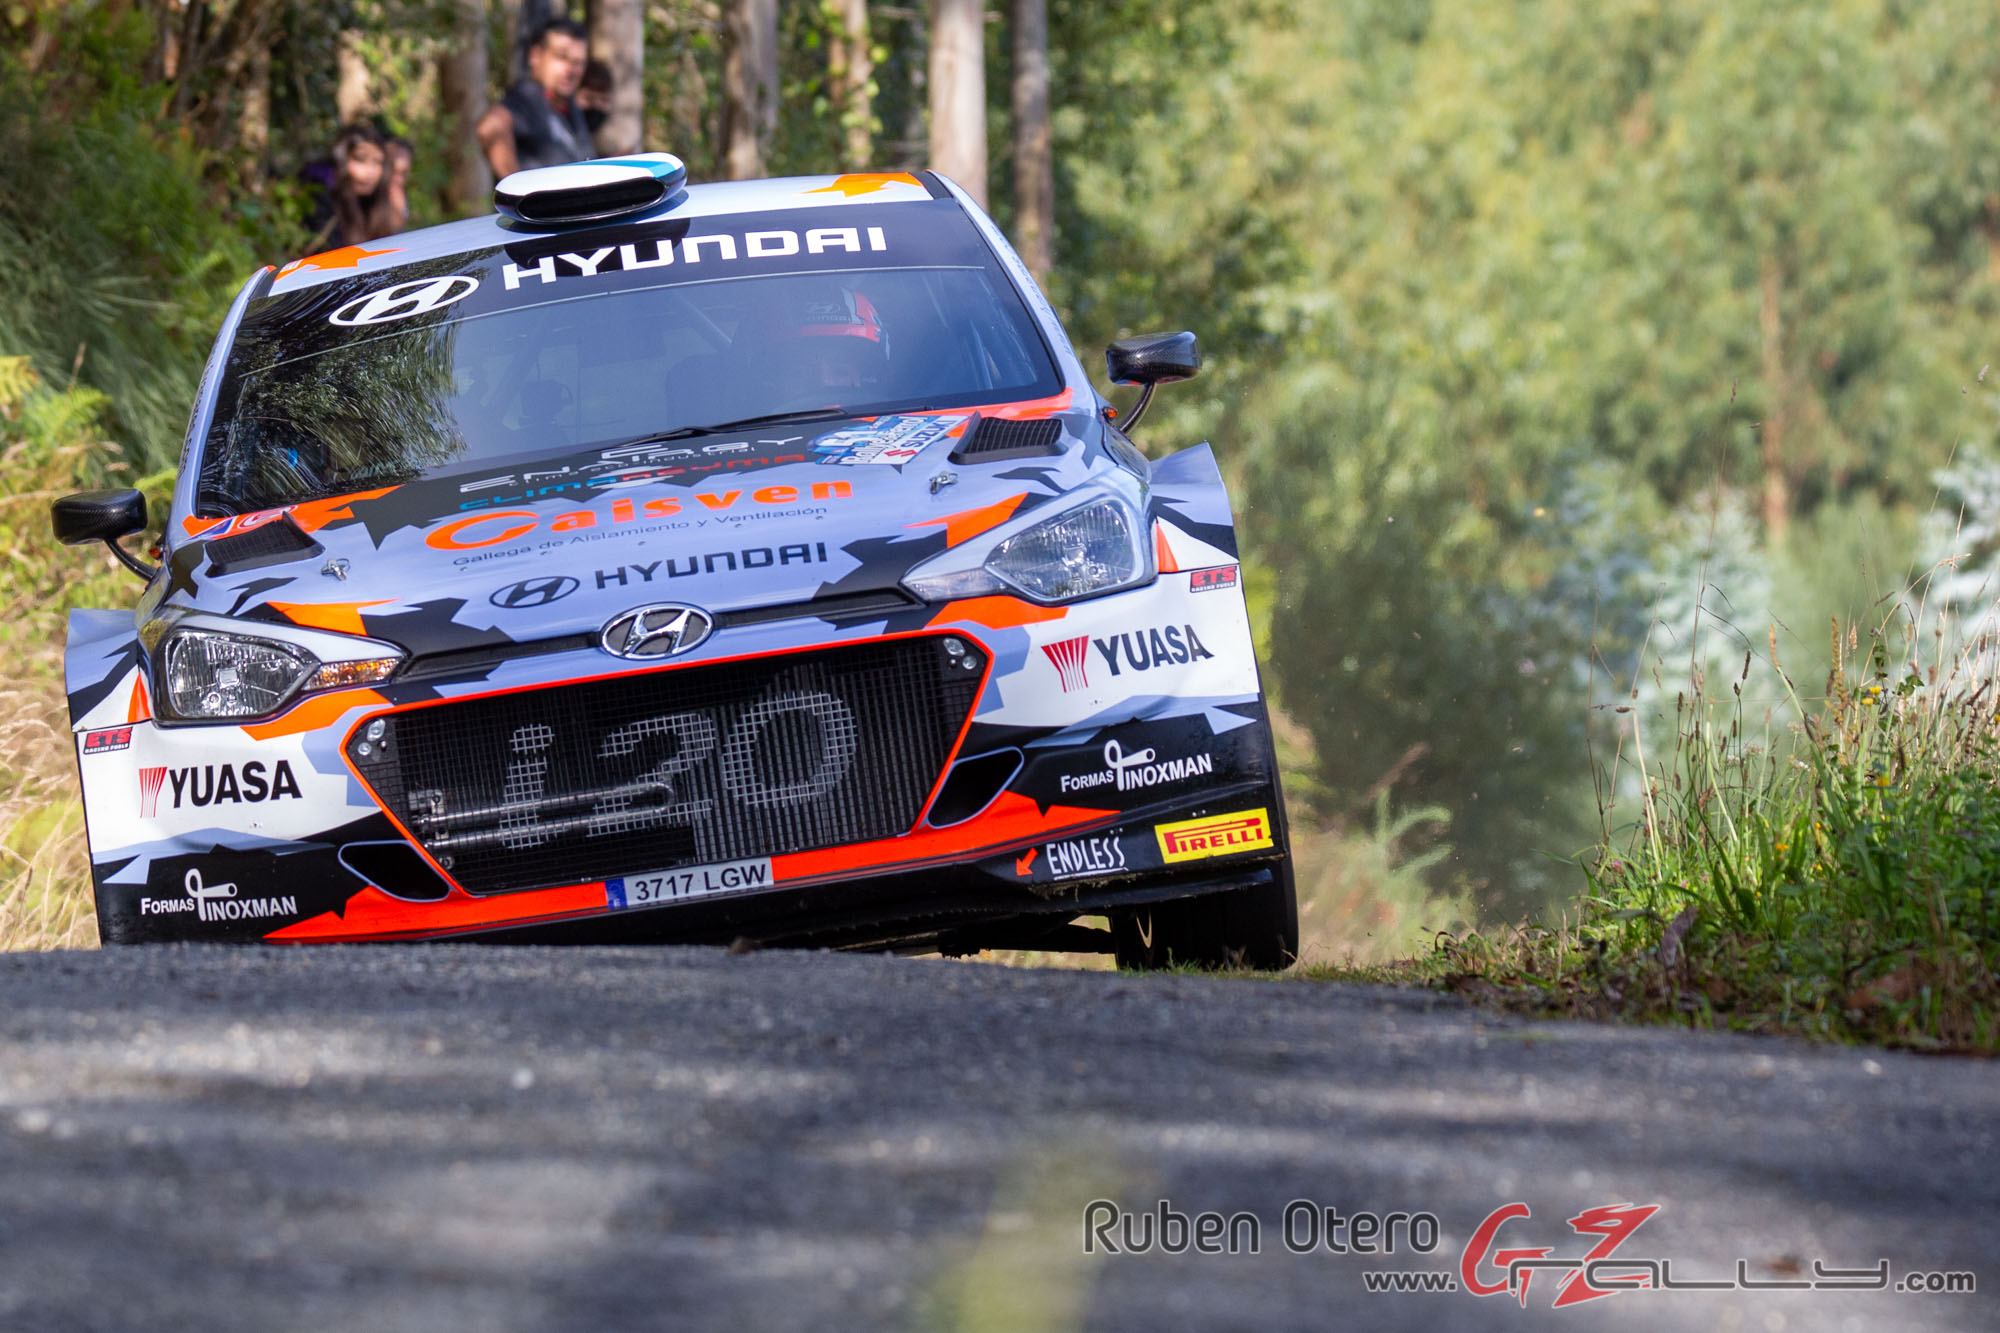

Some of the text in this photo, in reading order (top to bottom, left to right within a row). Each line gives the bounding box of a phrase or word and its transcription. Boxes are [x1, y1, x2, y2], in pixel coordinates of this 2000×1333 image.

[502, 226, 888, 291] HYUNDAI
[901, 419, 957, 448] SUZUKI
[425, 480, 853, 550] Caisven
[453, 506, 828, 567] Gallega de Aislamiento y Ventilación
[595, 542, 828, 590] HYUNDAI
[1191, 566, 1237, 587] ETS
[1093, 624, 1215, 677] YUASA
[86, 726, 133, 748] ETS
[169, 759, 303, 809] YUASA
[1061, 769, 1114, 793] FORMAS
[1163, 817, 1264, 855] PIRELLI
[1046, 836, 1126, 876] ENDLESS
[635, 864, 766, 901] 3717 LGW
[140, 897, 195, 915] FORMAS
